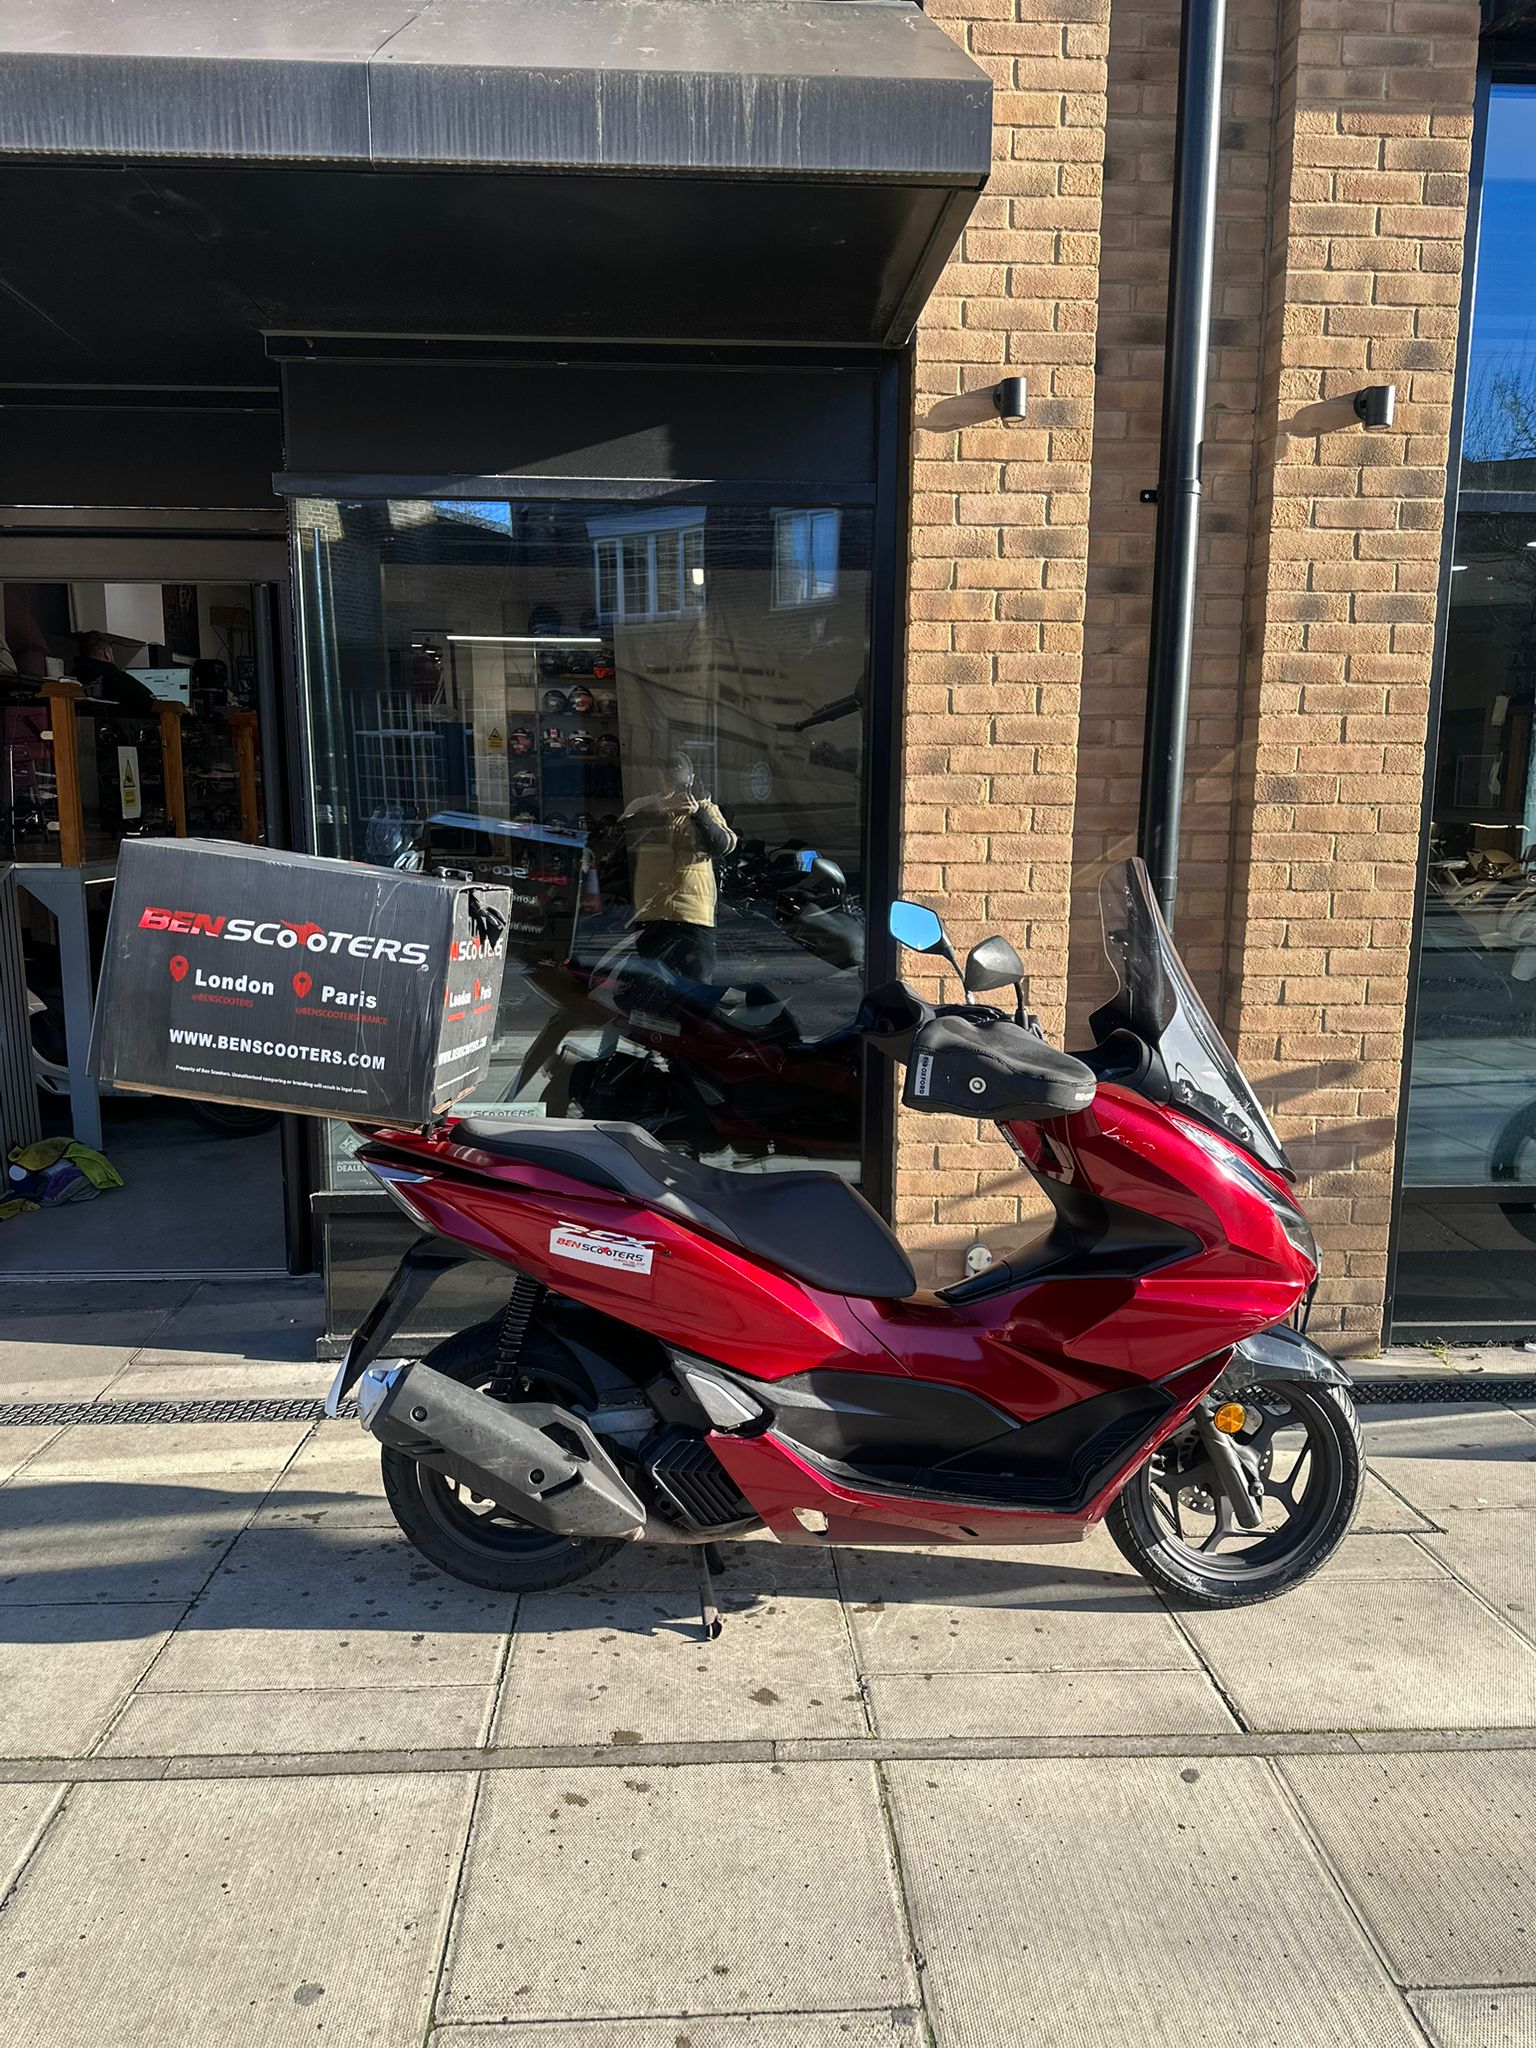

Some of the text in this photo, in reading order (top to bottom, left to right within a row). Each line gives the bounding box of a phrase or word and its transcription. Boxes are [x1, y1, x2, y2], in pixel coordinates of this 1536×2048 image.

[194, 968, 274, 996] London
[191, 993, 254, 1008] @BENSCOOTERS
[321, 985, 377, 1009] Paris
[169, 1028, 386, 1071] WWW.BENSCOOTERS.COM
[175, 1064, 195, 1073] Property
[918, 1067, 927, 1095] OXFORD
